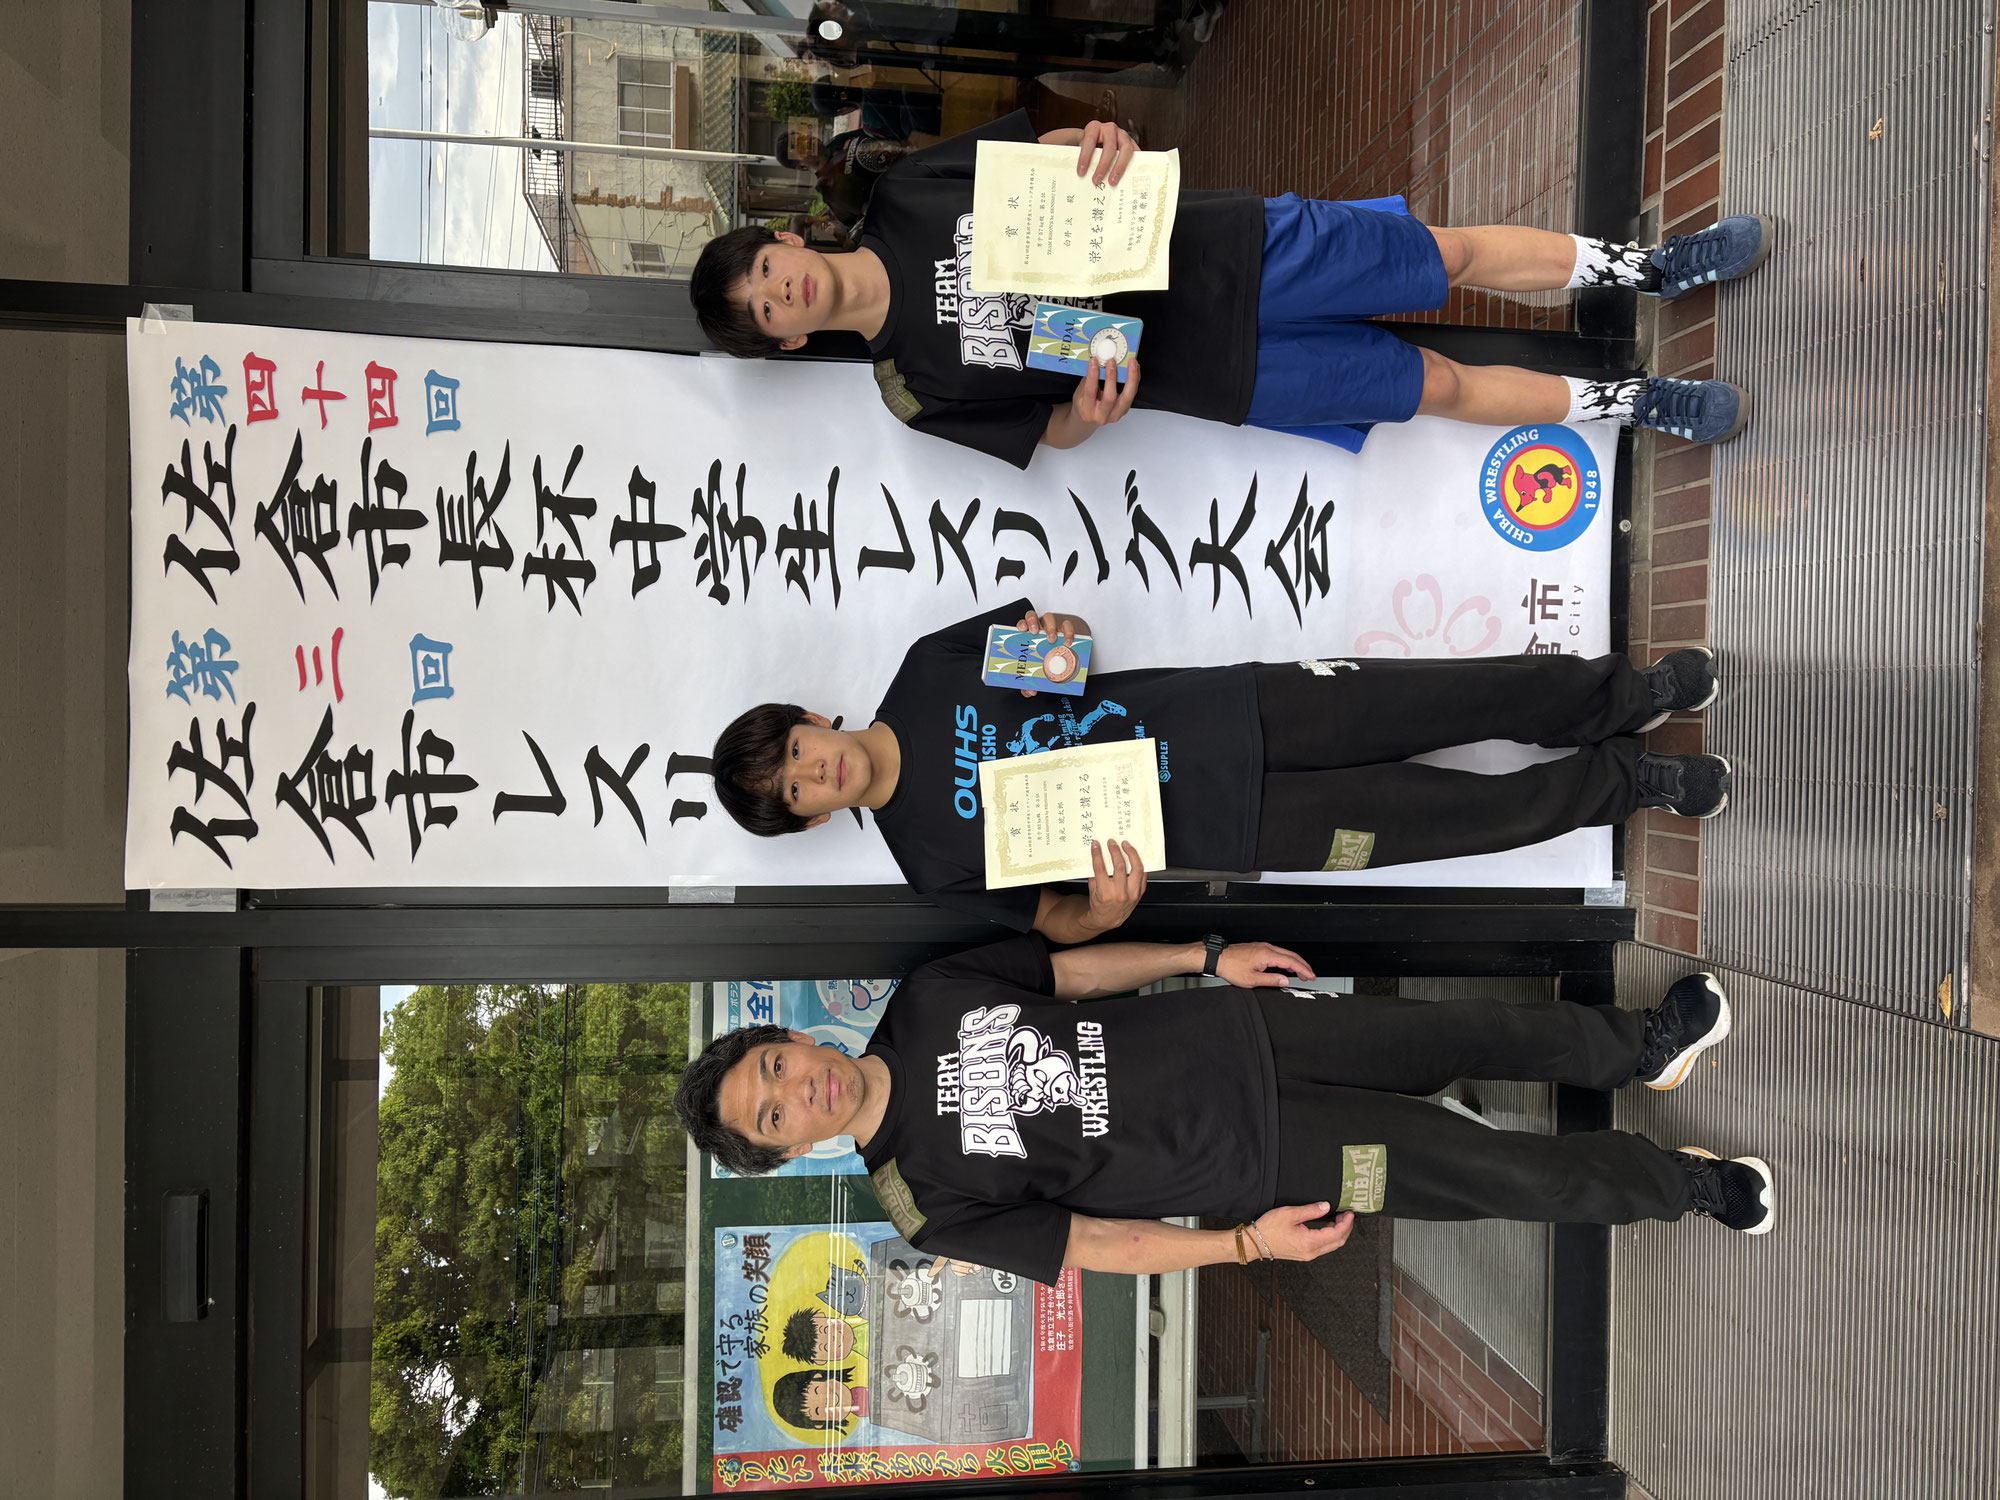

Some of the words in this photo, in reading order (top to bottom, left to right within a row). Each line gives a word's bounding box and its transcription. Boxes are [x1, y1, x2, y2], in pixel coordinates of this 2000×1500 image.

[1088, 181, 1106, 264] 栄光を讃える
[934, 257, 958, 324] TEAM
[1058, 319, 1076, 363] MEDAL
[169, 352, 460, 436] 第四十四回
[1484, 428, 1540, 504] WRESTLING
[1584, 470, 1598, 509] 1948
[161, 424, 1334, 629] 佐倉市長杯中学生レスリング大会
[1492, 508, 1534, 544] CHIBA
[1568, 585, 1584, 636] City
[165, 628, 454, 705] 第三回
[1015, 640, 1030, 681] MEDAL
[954, 704, 978, 819] OUHS
[1160, 741, 1168, 770] SUPLEX
[937, 1051, 960, 1115] TEAM
[957, 1004, 1028, 1159] BISON'S
[1077, 1021, 1109, 1138] WRESTLING
[894, 1179, 913, 1211] TOKYO
[1374, 1167, 1384, 1200] TOKYO
[742, 1232, 772, 1359] 家族の笑顔
[997, 1271, 1012, 1289] OK
[1056, 1330, 1066, 1351] 庄子
[715, 1314, 744, 1434] 確認で守る
[985, 1439, 1073, 1475] 火の用心
